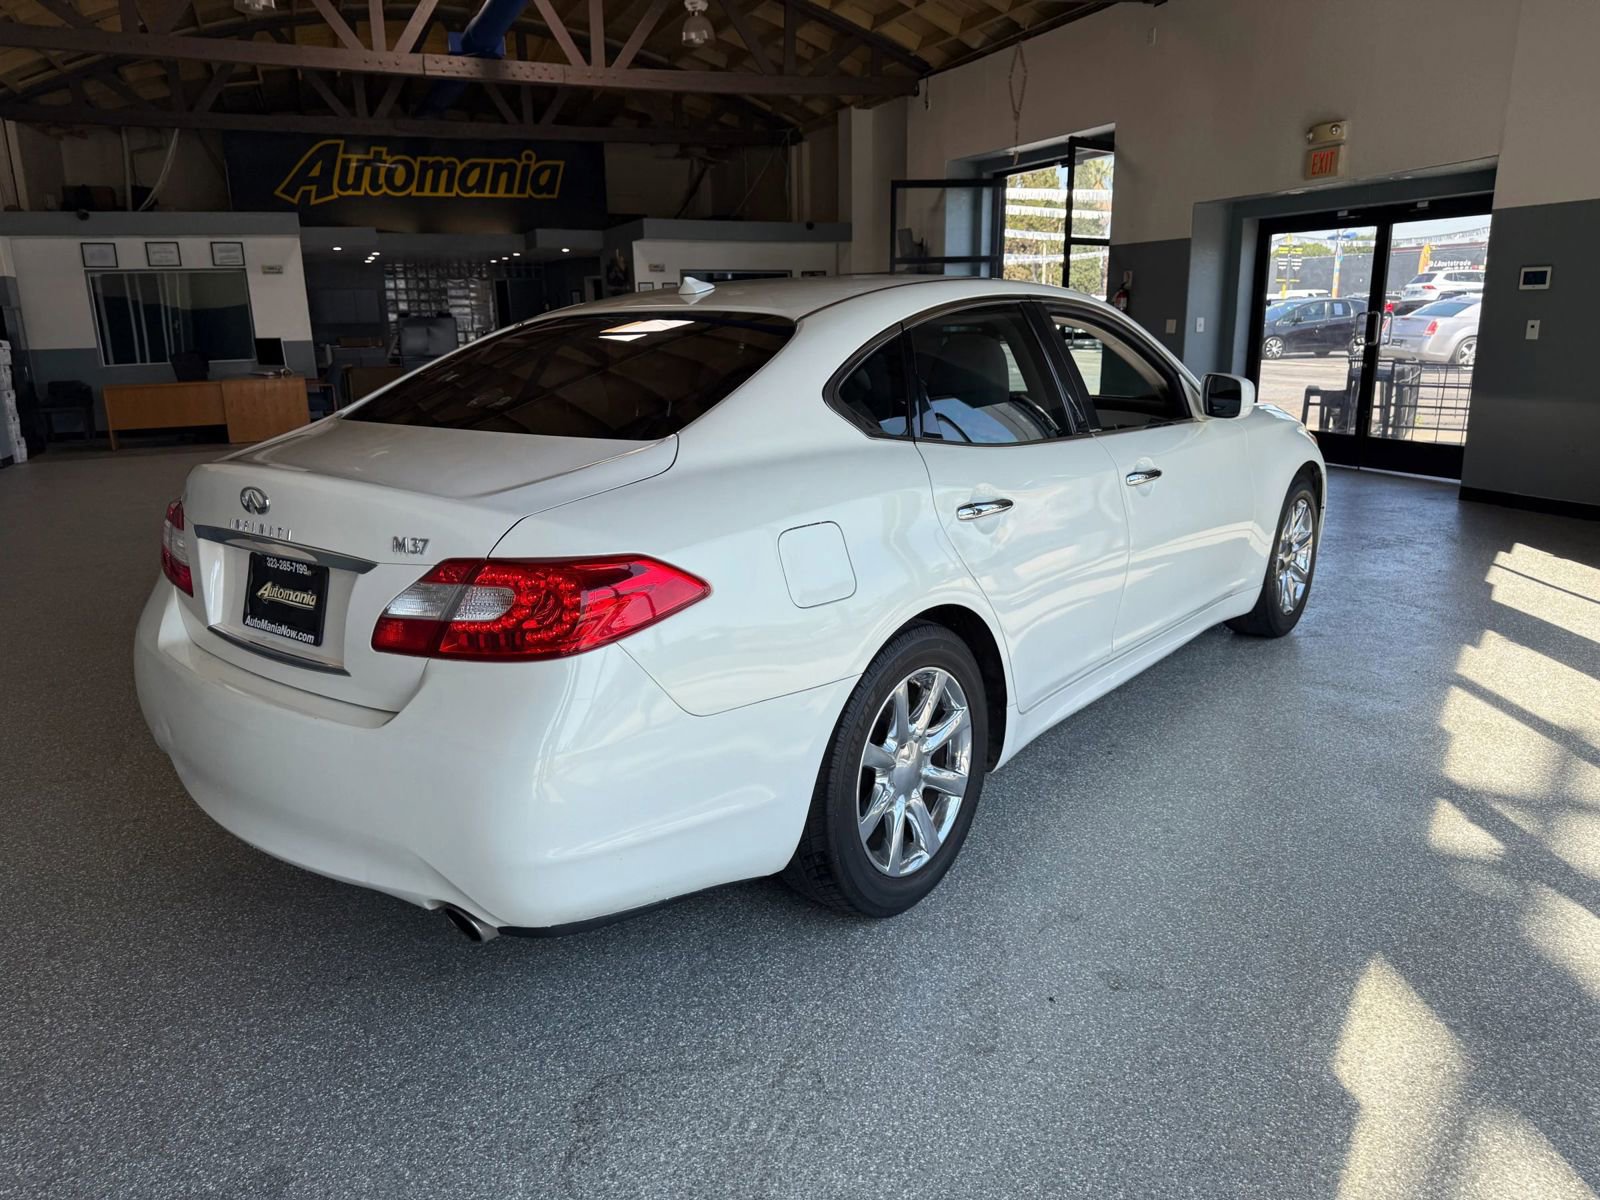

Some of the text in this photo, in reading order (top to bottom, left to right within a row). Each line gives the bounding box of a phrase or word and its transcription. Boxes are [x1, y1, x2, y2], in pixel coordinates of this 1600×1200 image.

[273, 139, 565, 205] Automania
[1311, 151, 1335, 175] EXIT
[229, 518, 291, 541] INFINITI
[391, 535, 429, 555] M37
[266, 556, 308, 574] 323-285-7199
[255, 580, 317, 606] Automania
[245, 614, 315, 644] AutoManiaNow.com
